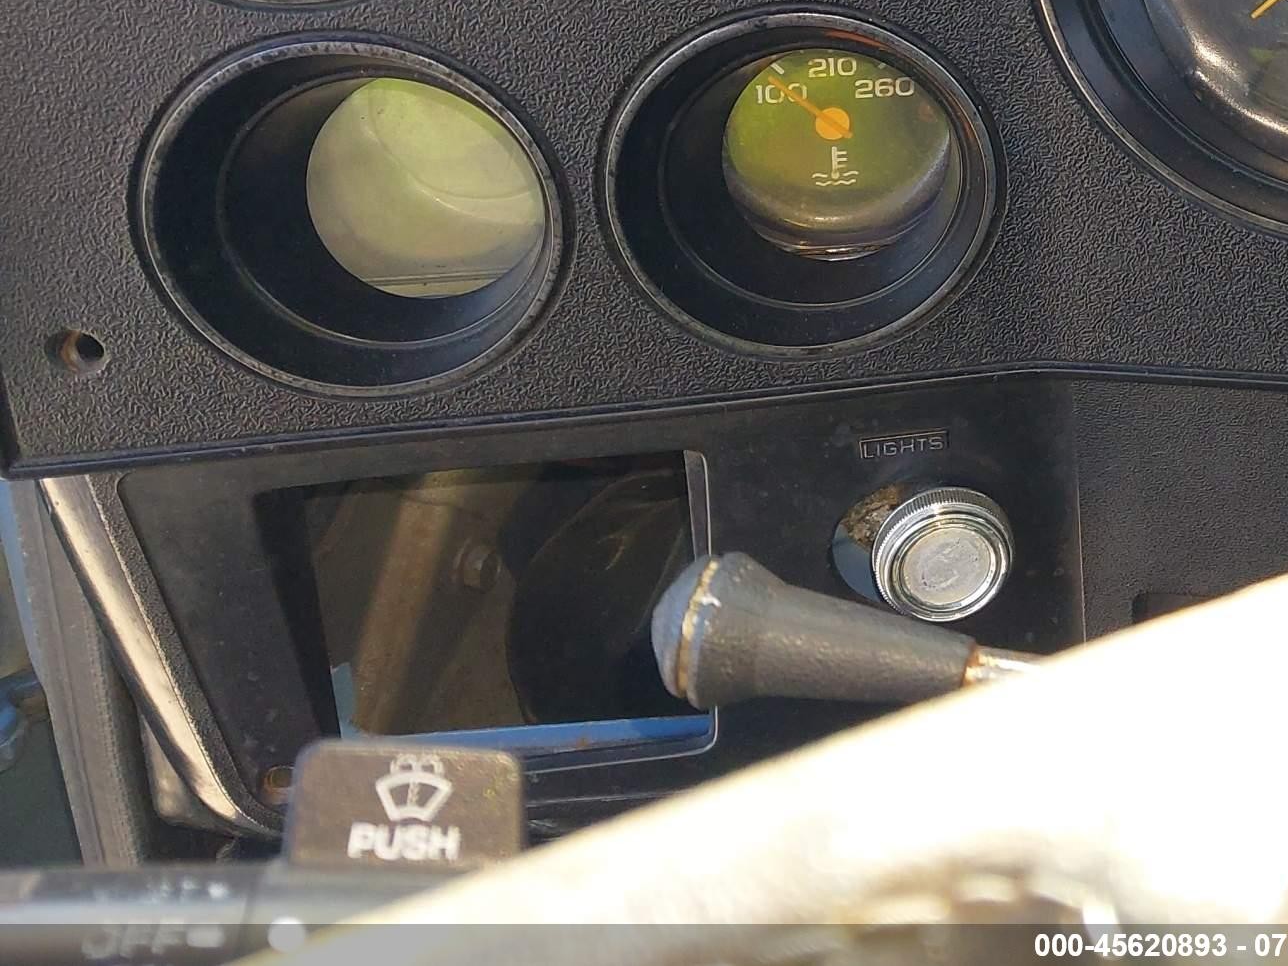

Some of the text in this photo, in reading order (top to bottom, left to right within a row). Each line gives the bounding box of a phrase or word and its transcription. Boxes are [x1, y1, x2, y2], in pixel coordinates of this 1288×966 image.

[808, 57, 857, 78] 210
[755, 83, 808, 104] 100
[854, 77, 915, 99] 260
[863, 437, 944, 459] LIGHTS
[347, 822, 461, 861] PUSH
